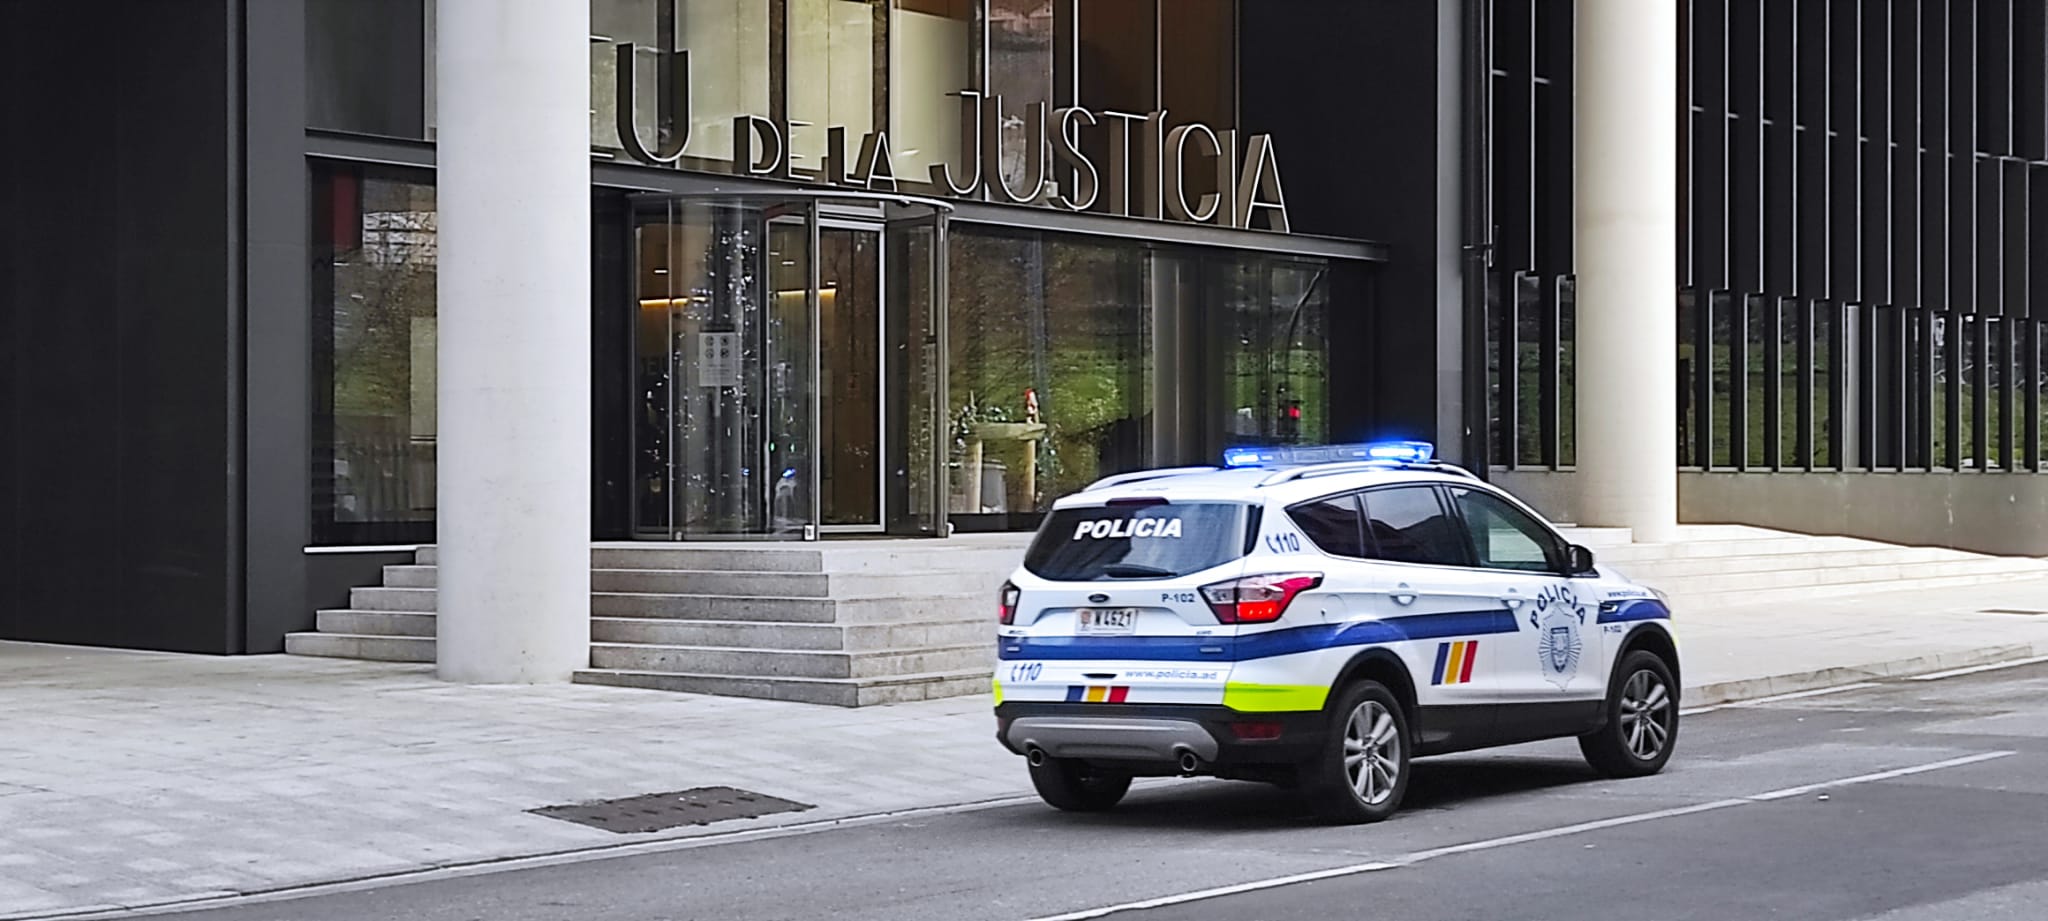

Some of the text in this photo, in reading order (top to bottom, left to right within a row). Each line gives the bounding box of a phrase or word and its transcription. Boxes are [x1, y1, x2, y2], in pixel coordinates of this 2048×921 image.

[733, 115, 815, 180] DE
[828, 126, 897, 192] LA
[929, 90, 1290, 233] JUSTÍCIA
[1073, 518, 1182, 540] POLICIA
[1161, 593, 1195, 603] P-102
[1530, 584, 1587, 629] POLICIA
[1125, 668, 1217, 680] www.policia.ad
